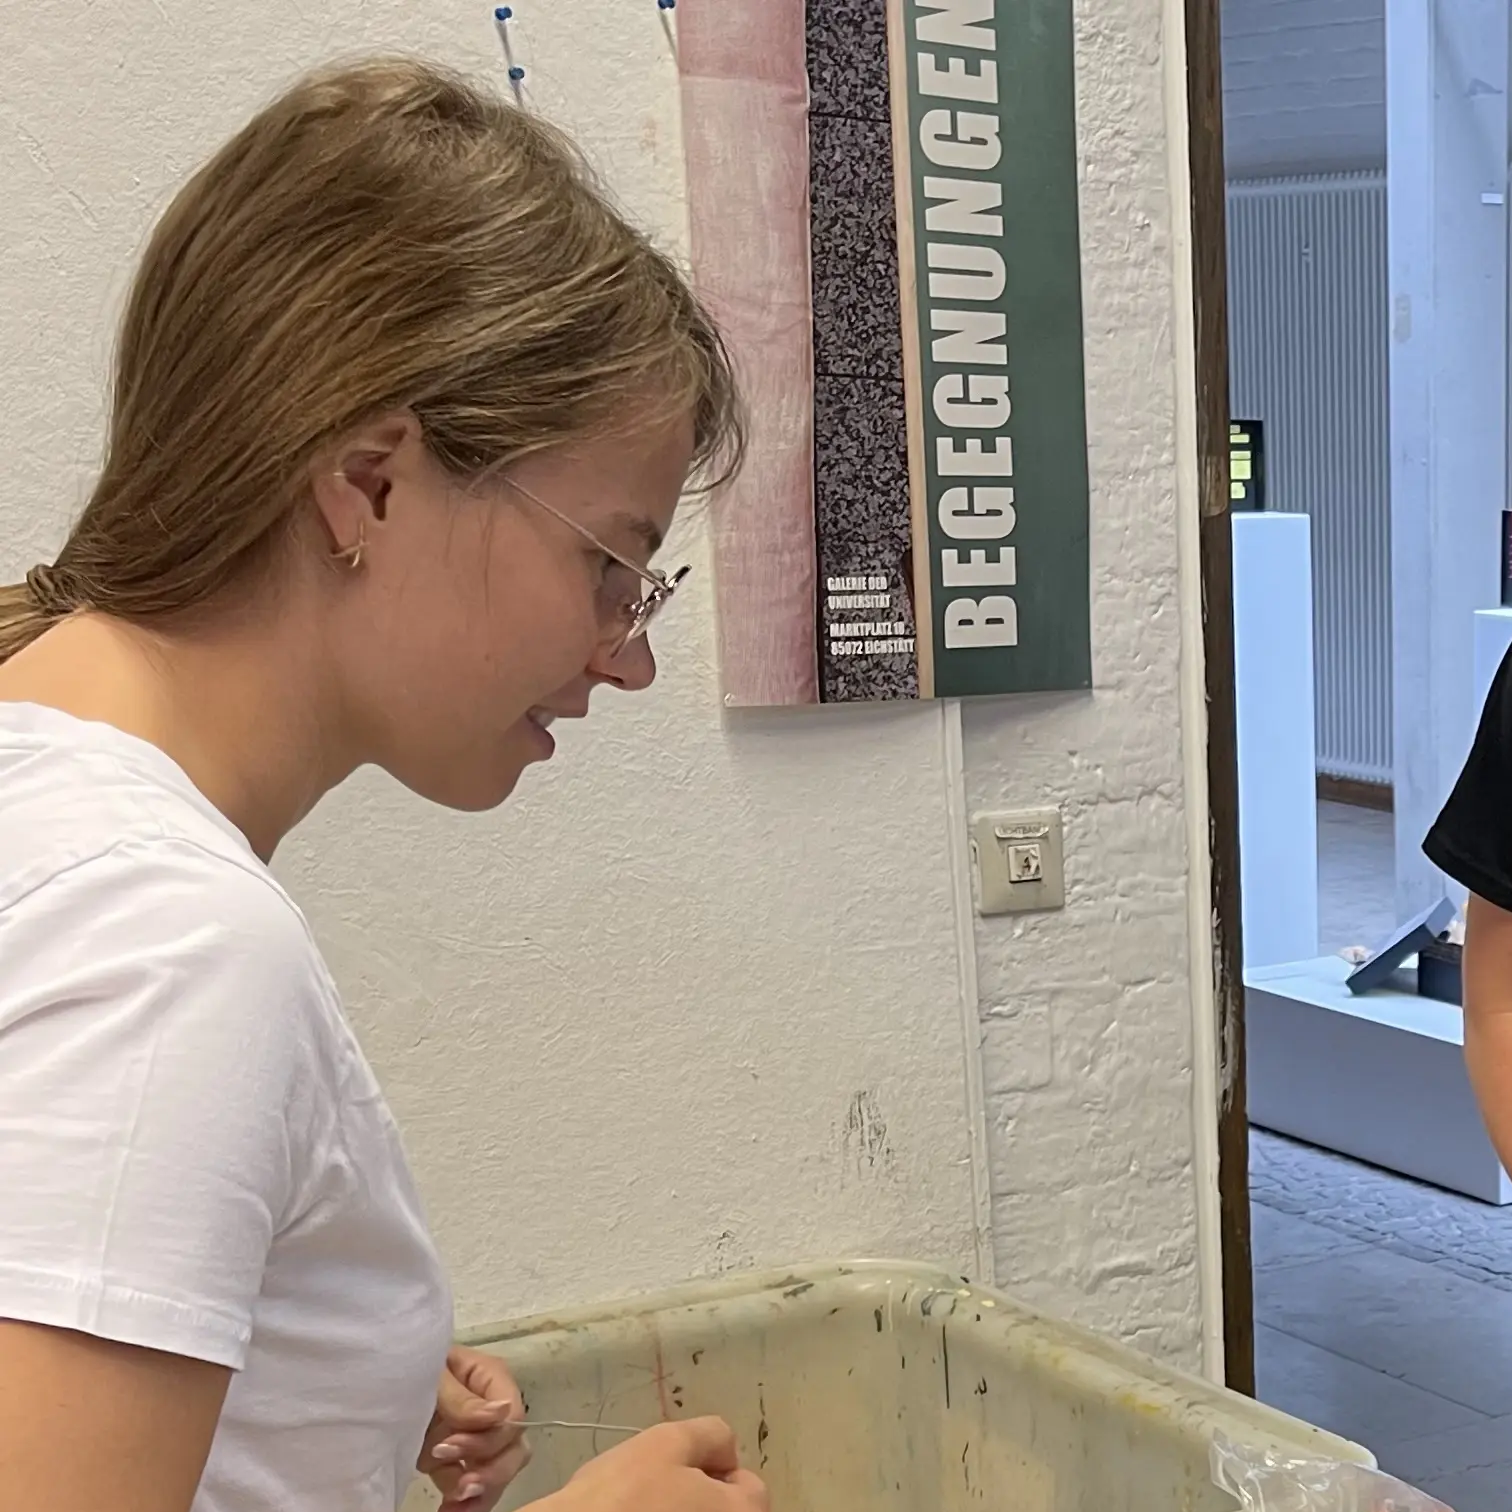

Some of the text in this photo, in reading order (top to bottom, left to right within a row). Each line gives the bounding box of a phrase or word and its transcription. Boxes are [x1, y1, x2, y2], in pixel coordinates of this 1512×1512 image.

[915, 0, 1018, 649] BEGEGNUNGEN
[827, 576, 888, 591] GALERIE DER
[828, 593, 891, 610] UNIVERSITÄT
[830, 621, 905, 637] MARKTPLATZ 10
[831, 638, 915, 656] 85072 EICHSTÄTT
